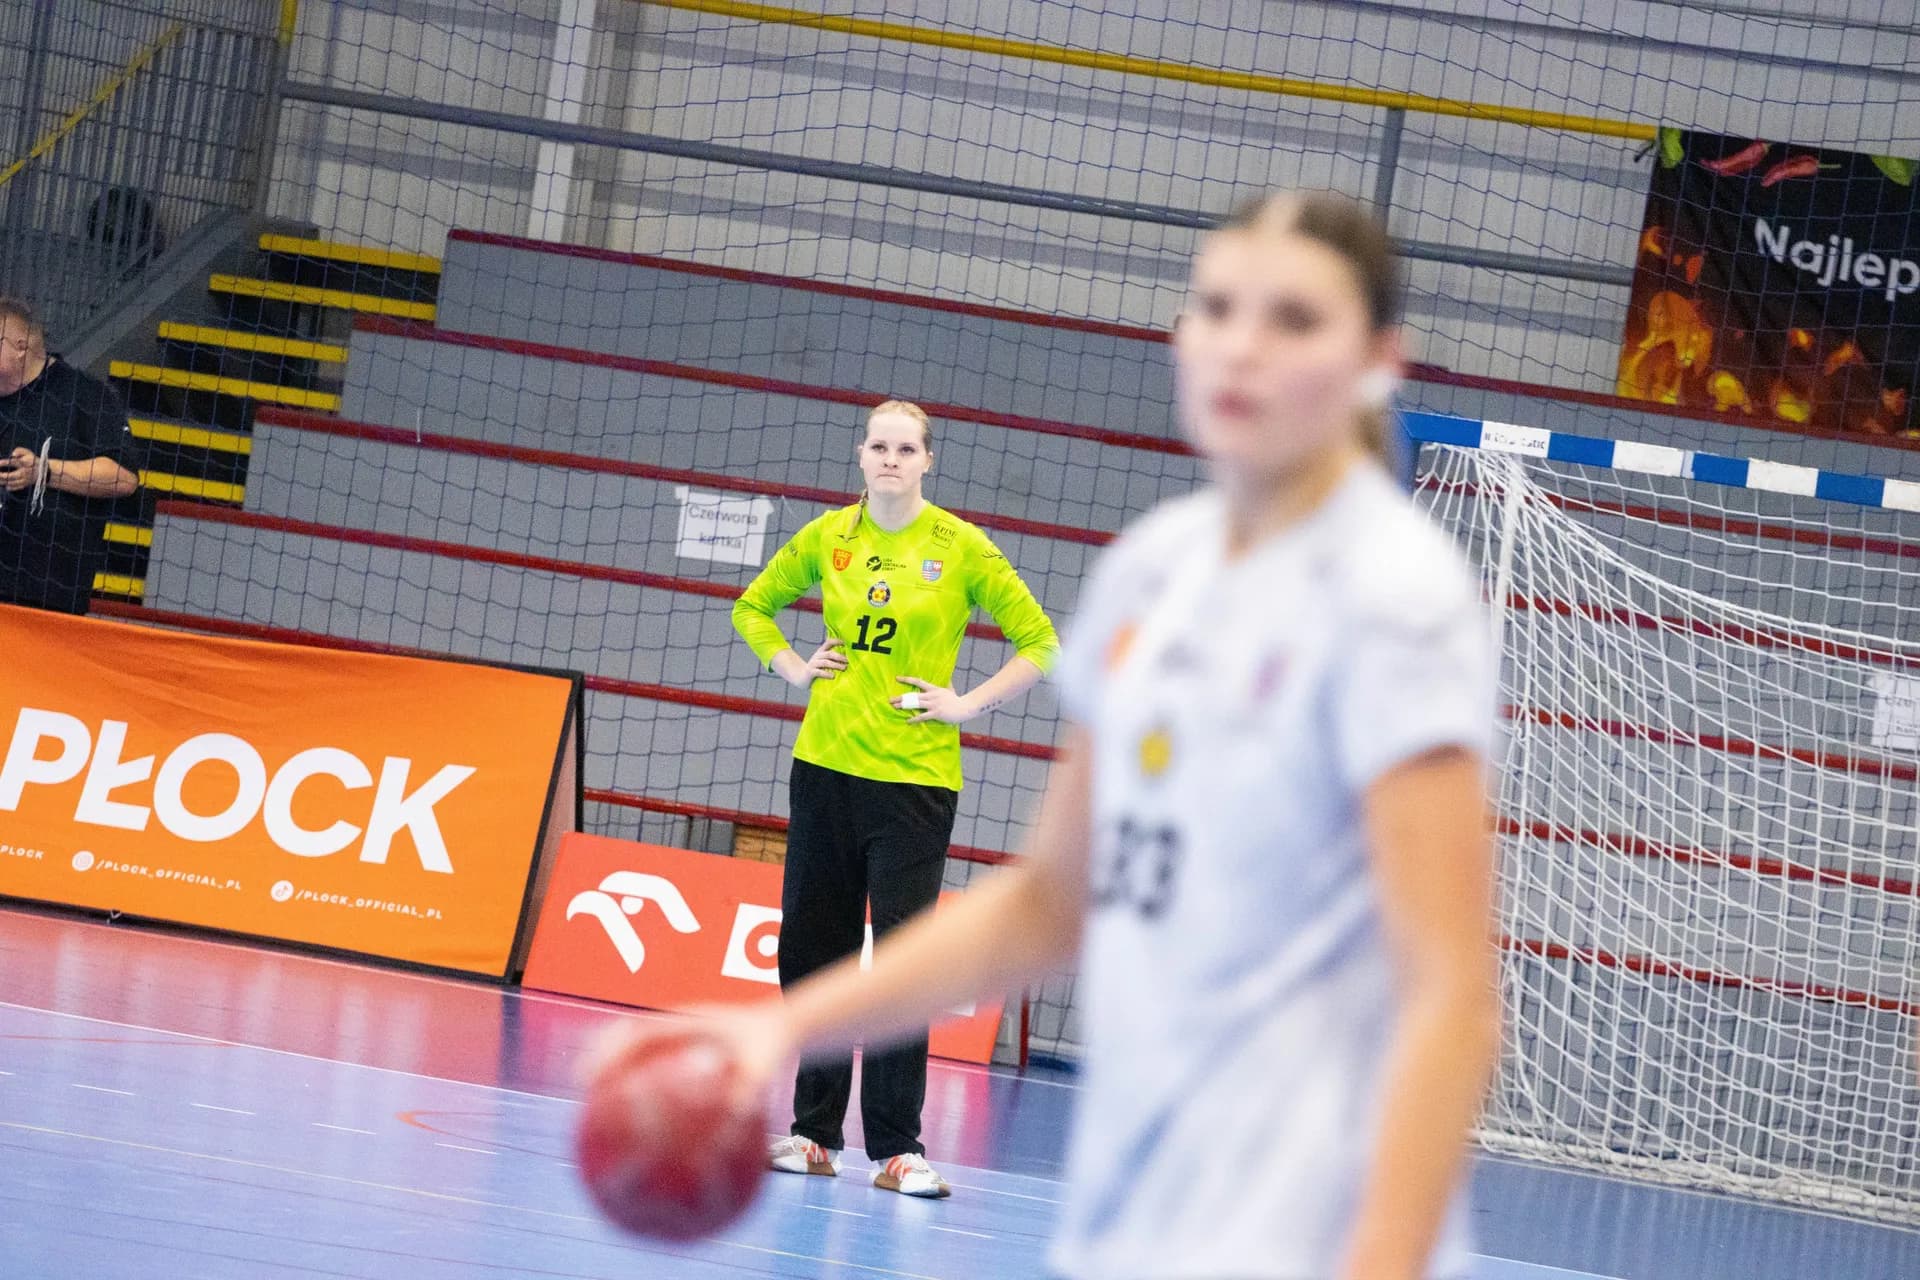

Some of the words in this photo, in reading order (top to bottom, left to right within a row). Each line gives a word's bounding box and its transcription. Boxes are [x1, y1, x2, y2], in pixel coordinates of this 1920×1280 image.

[1754, 217, 1920, 302] Najlep
[851, 614, 898, 656] 12
[0, 707, 477, 875] PŁOCK
